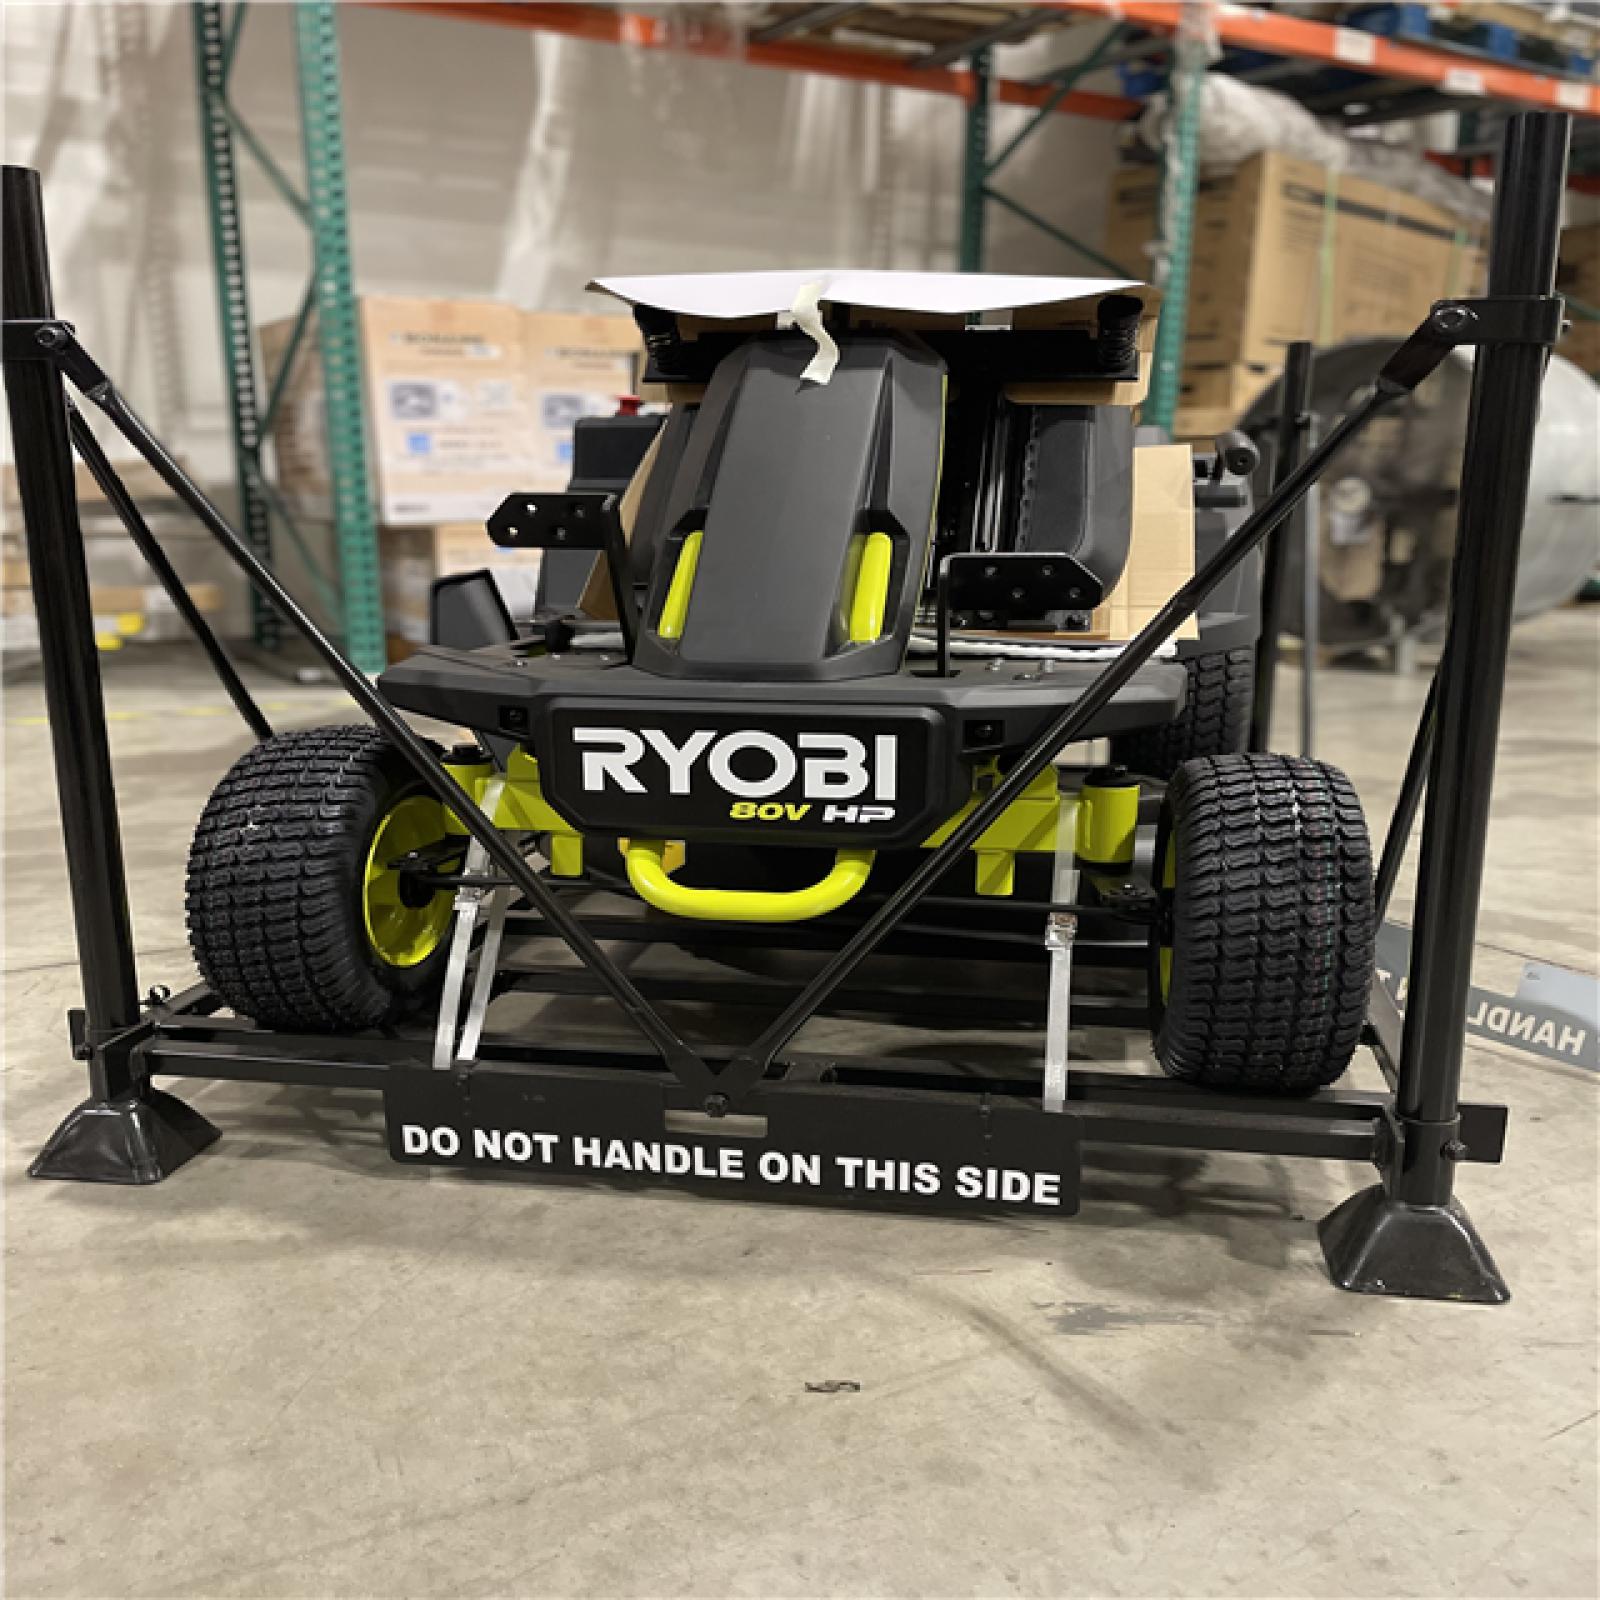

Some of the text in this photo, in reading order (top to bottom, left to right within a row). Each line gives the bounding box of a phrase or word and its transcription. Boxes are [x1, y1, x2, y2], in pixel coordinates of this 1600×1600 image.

[572, 727, 898, 801] RYOBI
[729, 801, 896, 824] 80V HP
[402, 1124, 1062, 1206] DO NOT HANDLE ON THIS SIDE
